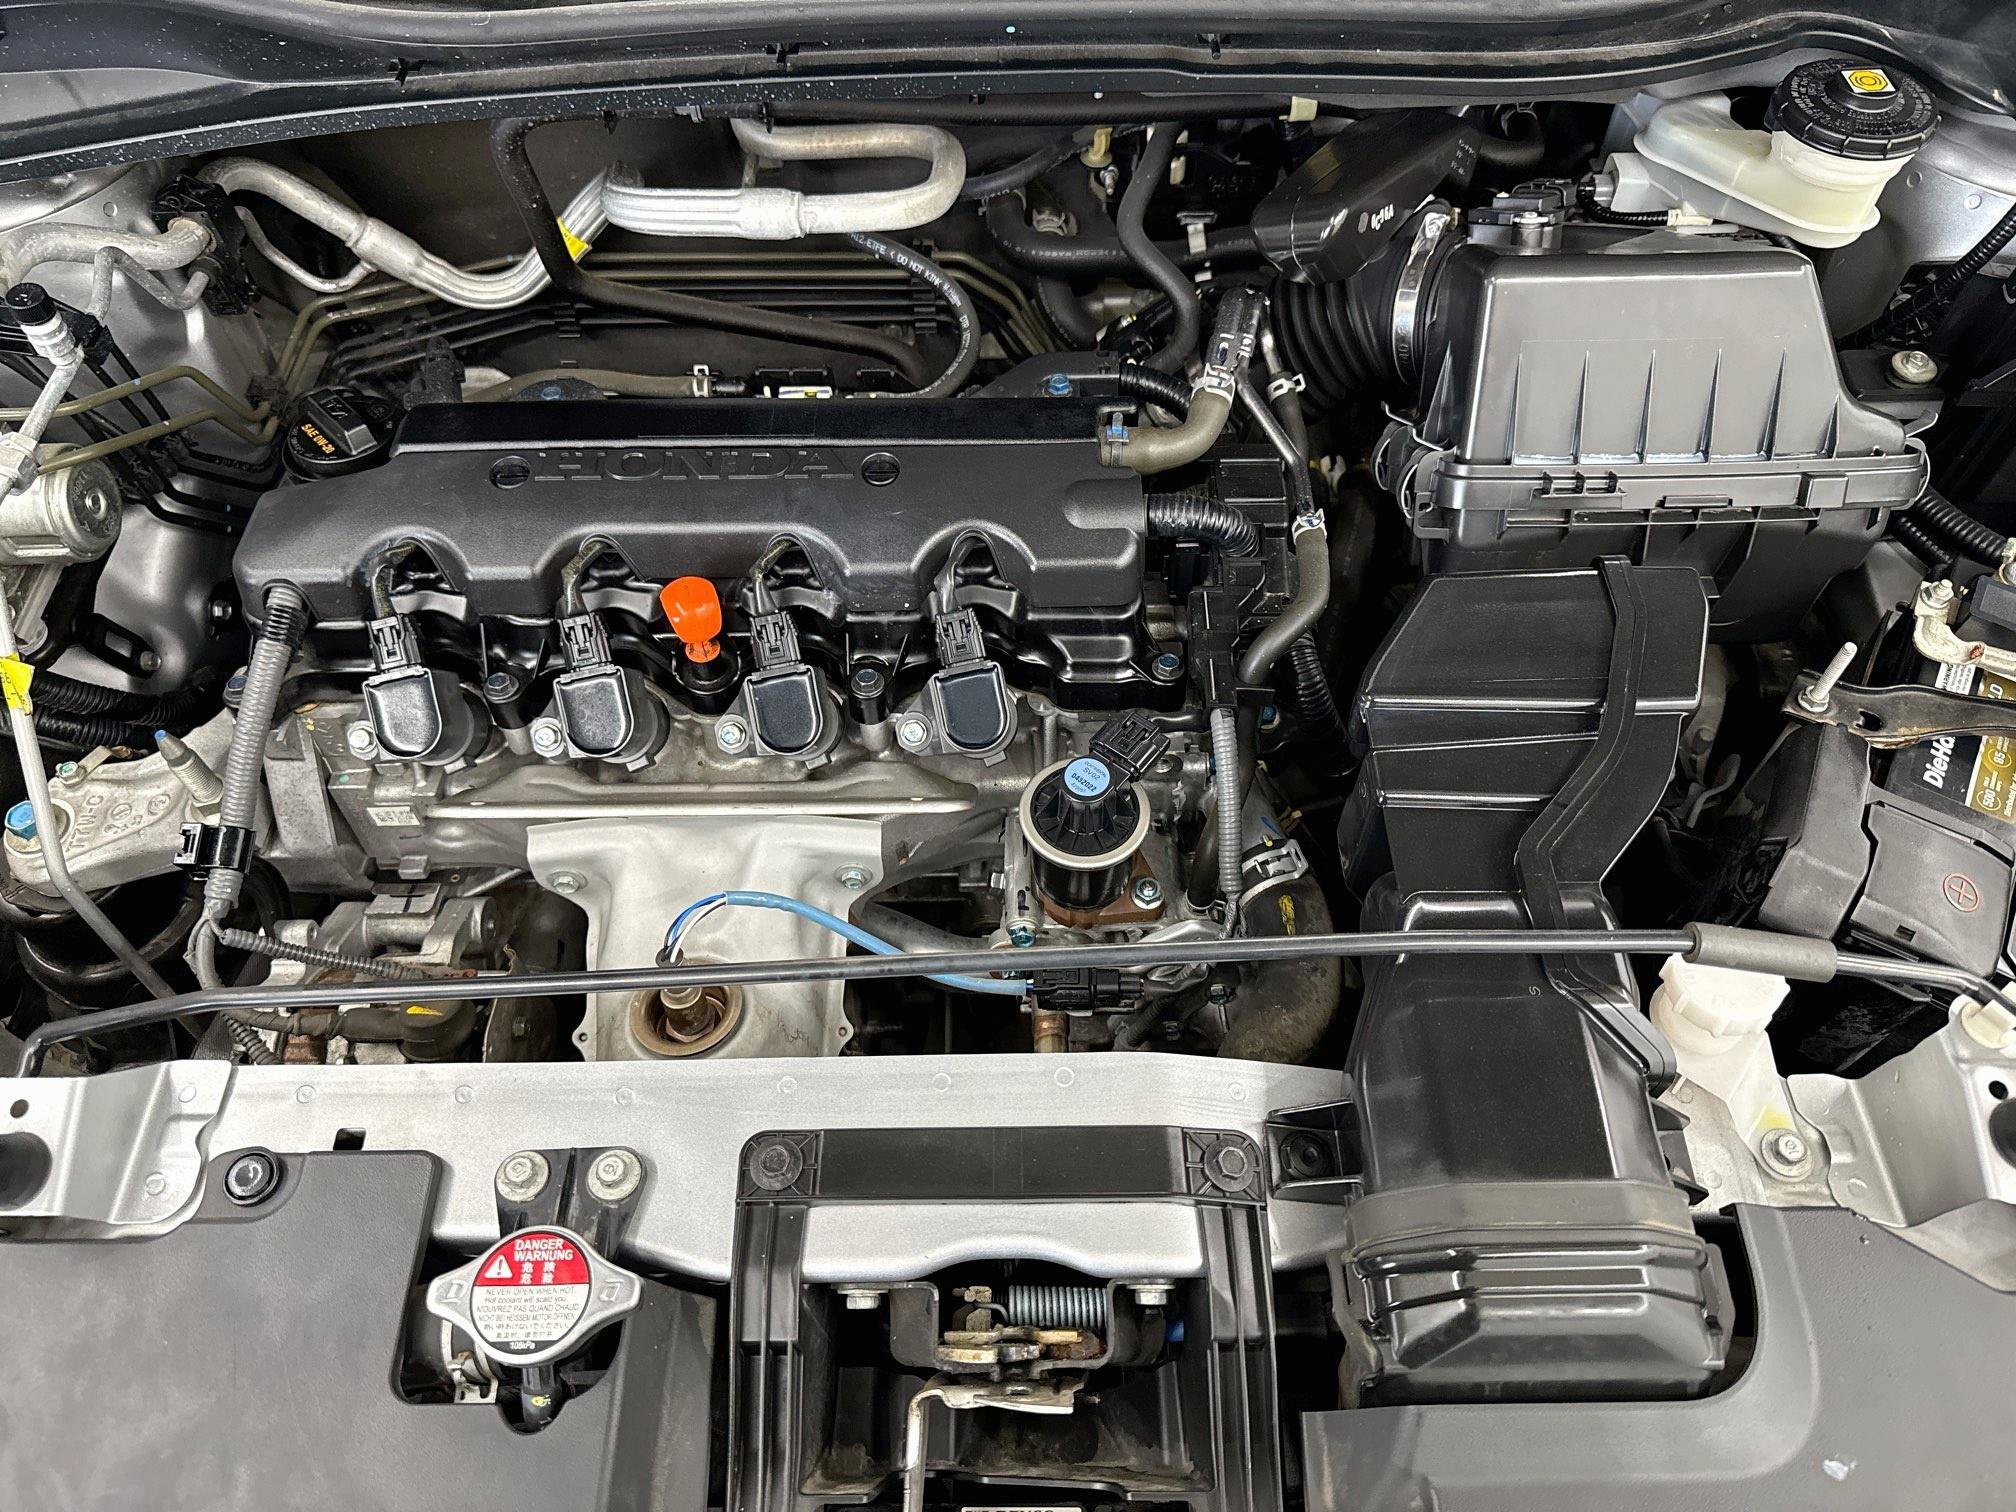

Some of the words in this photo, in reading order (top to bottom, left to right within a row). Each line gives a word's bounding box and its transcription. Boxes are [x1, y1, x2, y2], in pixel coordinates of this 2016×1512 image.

[896, 254, 909, 266] DO
[908, 260, 925, 275] NOT
[924, 268, 942, 288] KINK
[300, 423, 320, 438] SAE
[313, 434, 336, 454] 0W-20
[534, 452, 855, 481] HONDA
[1922, 736, 1956, 789] DieHa
[1993, 750, 2006, 765] 85
[1983, 788, 1996, 808] 500
[515, 1238, 563, 1250] DANGER
[514, 1249, 574, 1261] WARNUNG
[486, 1287, 511, 1296] NEVER
[513, 1287, 534, 1296] OPEN
[536, 1286, 557, 1295] WHEN
[514, 1304, 528, 1312] PAS
[529, 1304, 554, 1312] QUAND
